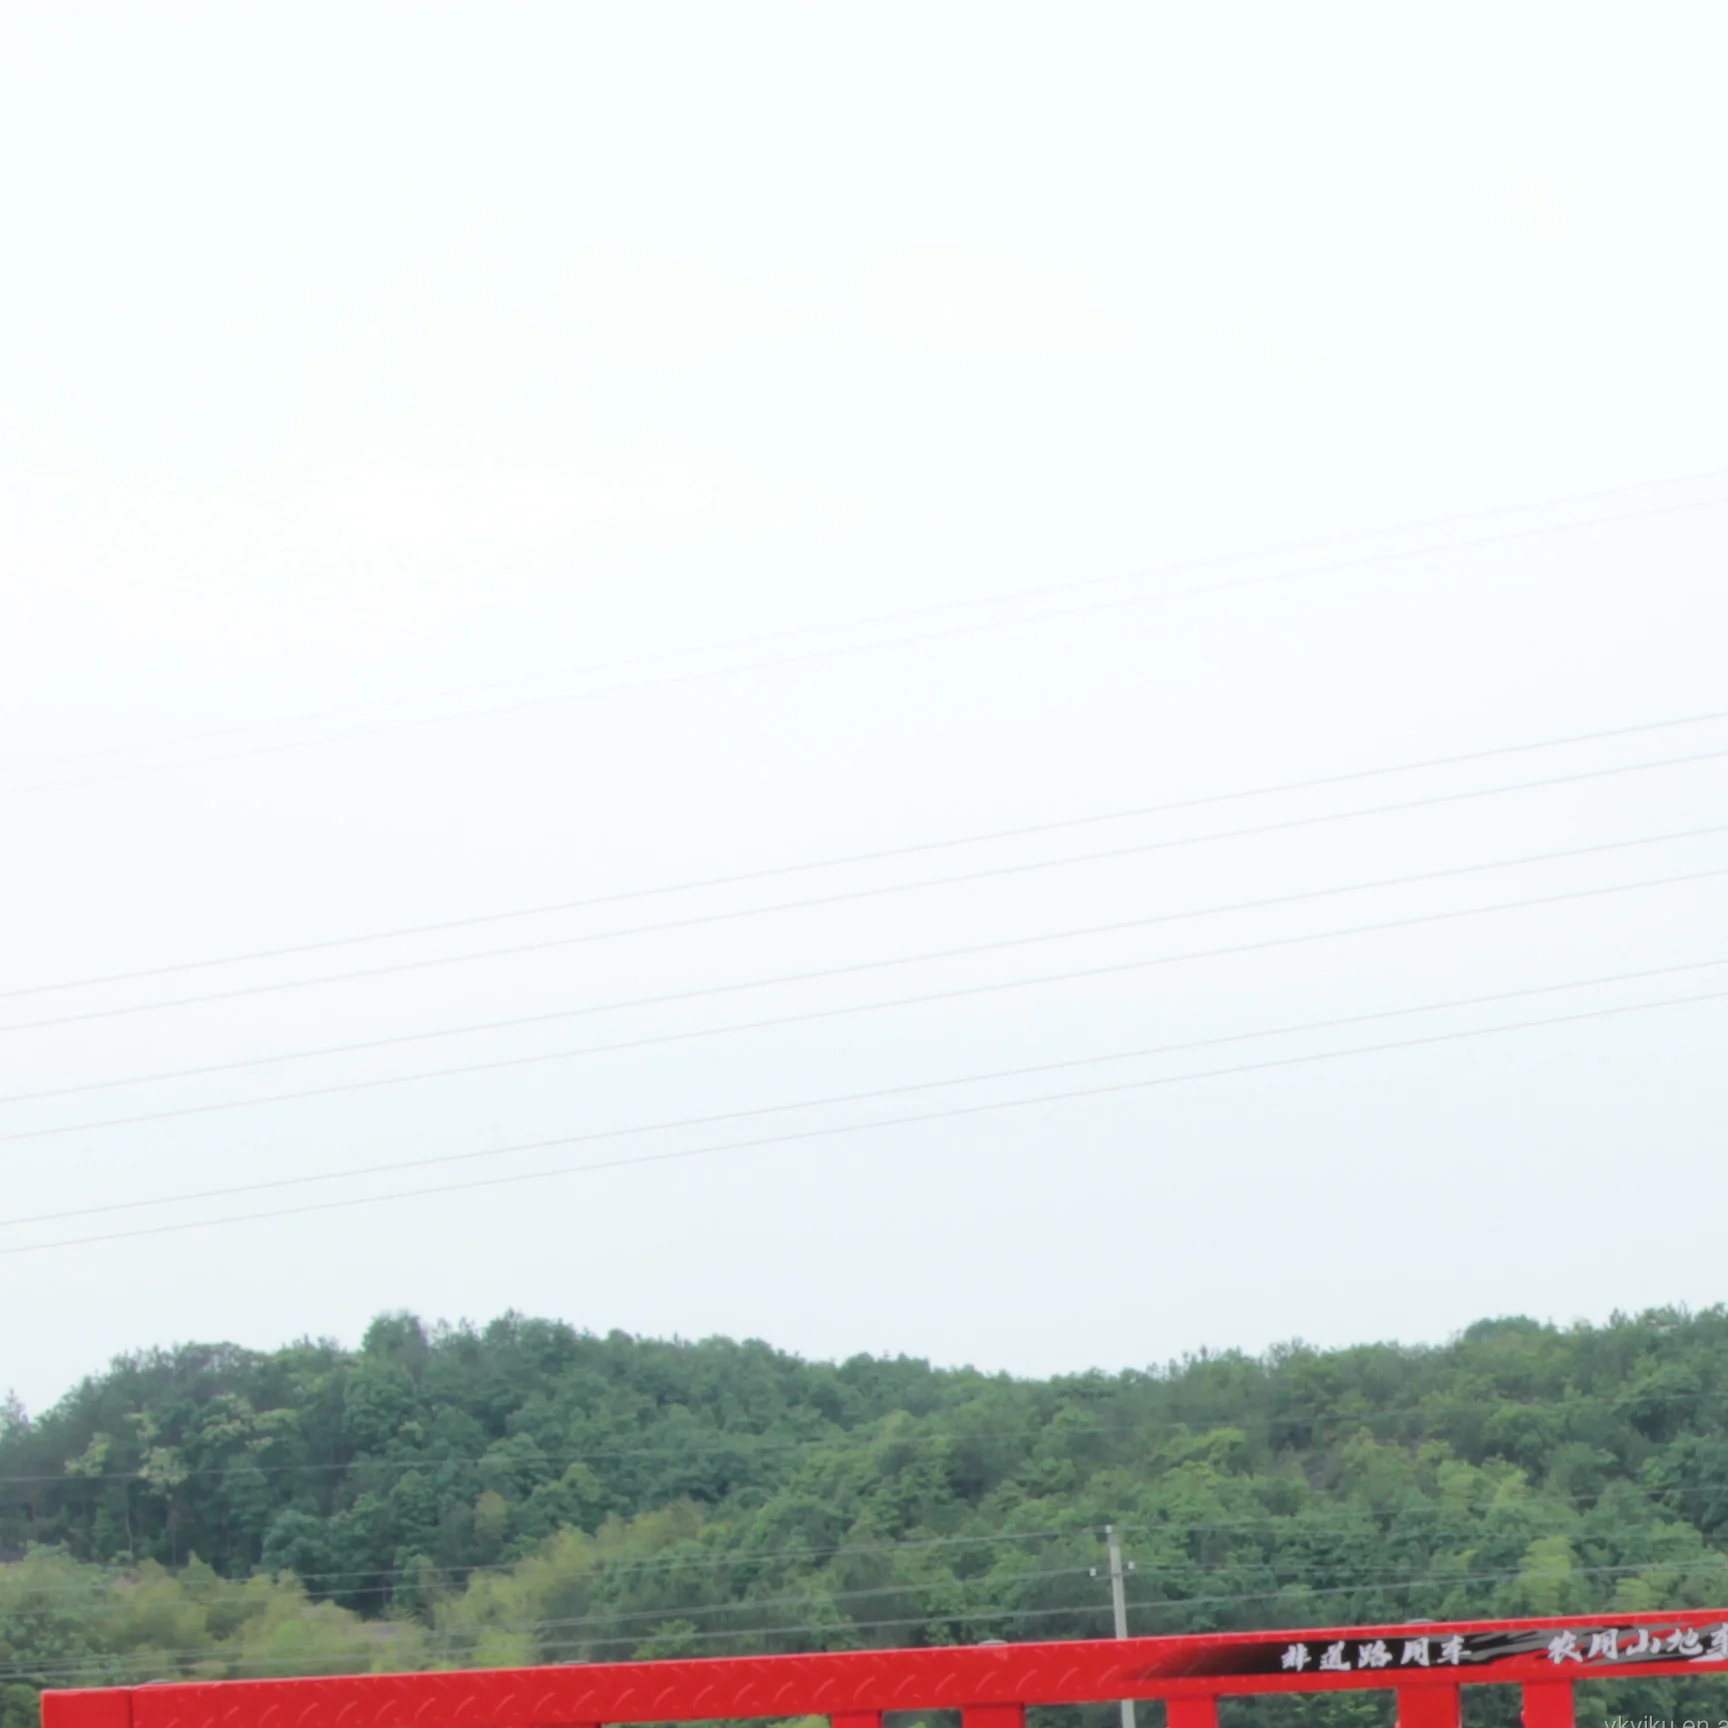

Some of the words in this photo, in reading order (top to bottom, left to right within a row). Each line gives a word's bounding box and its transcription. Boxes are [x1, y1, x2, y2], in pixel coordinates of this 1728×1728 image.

[1280, 1633, 1473, 1671] 非道路用车
